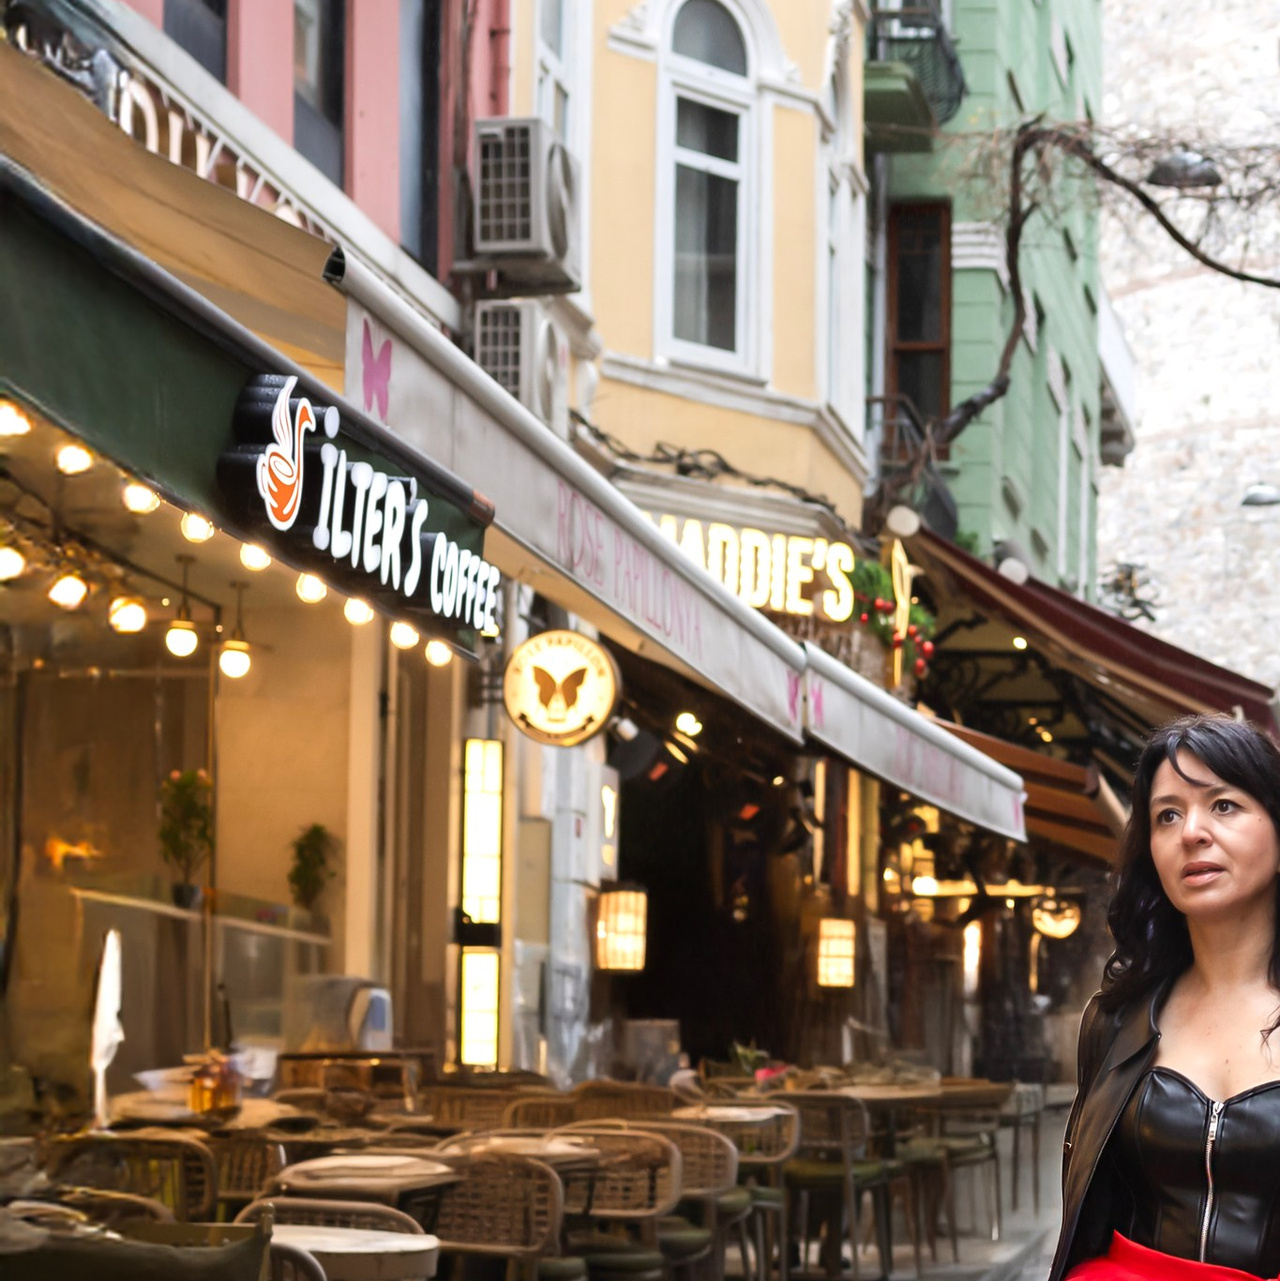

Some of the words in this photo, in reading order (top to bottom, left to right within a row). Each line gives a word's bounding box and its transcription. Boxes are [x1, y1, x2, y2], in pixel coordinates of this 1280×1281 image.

[313, 405, 429, 597] İLTER'S
[431, 531, 501, 633] COFFEE
[557, 480, 604, 587] ROSE
